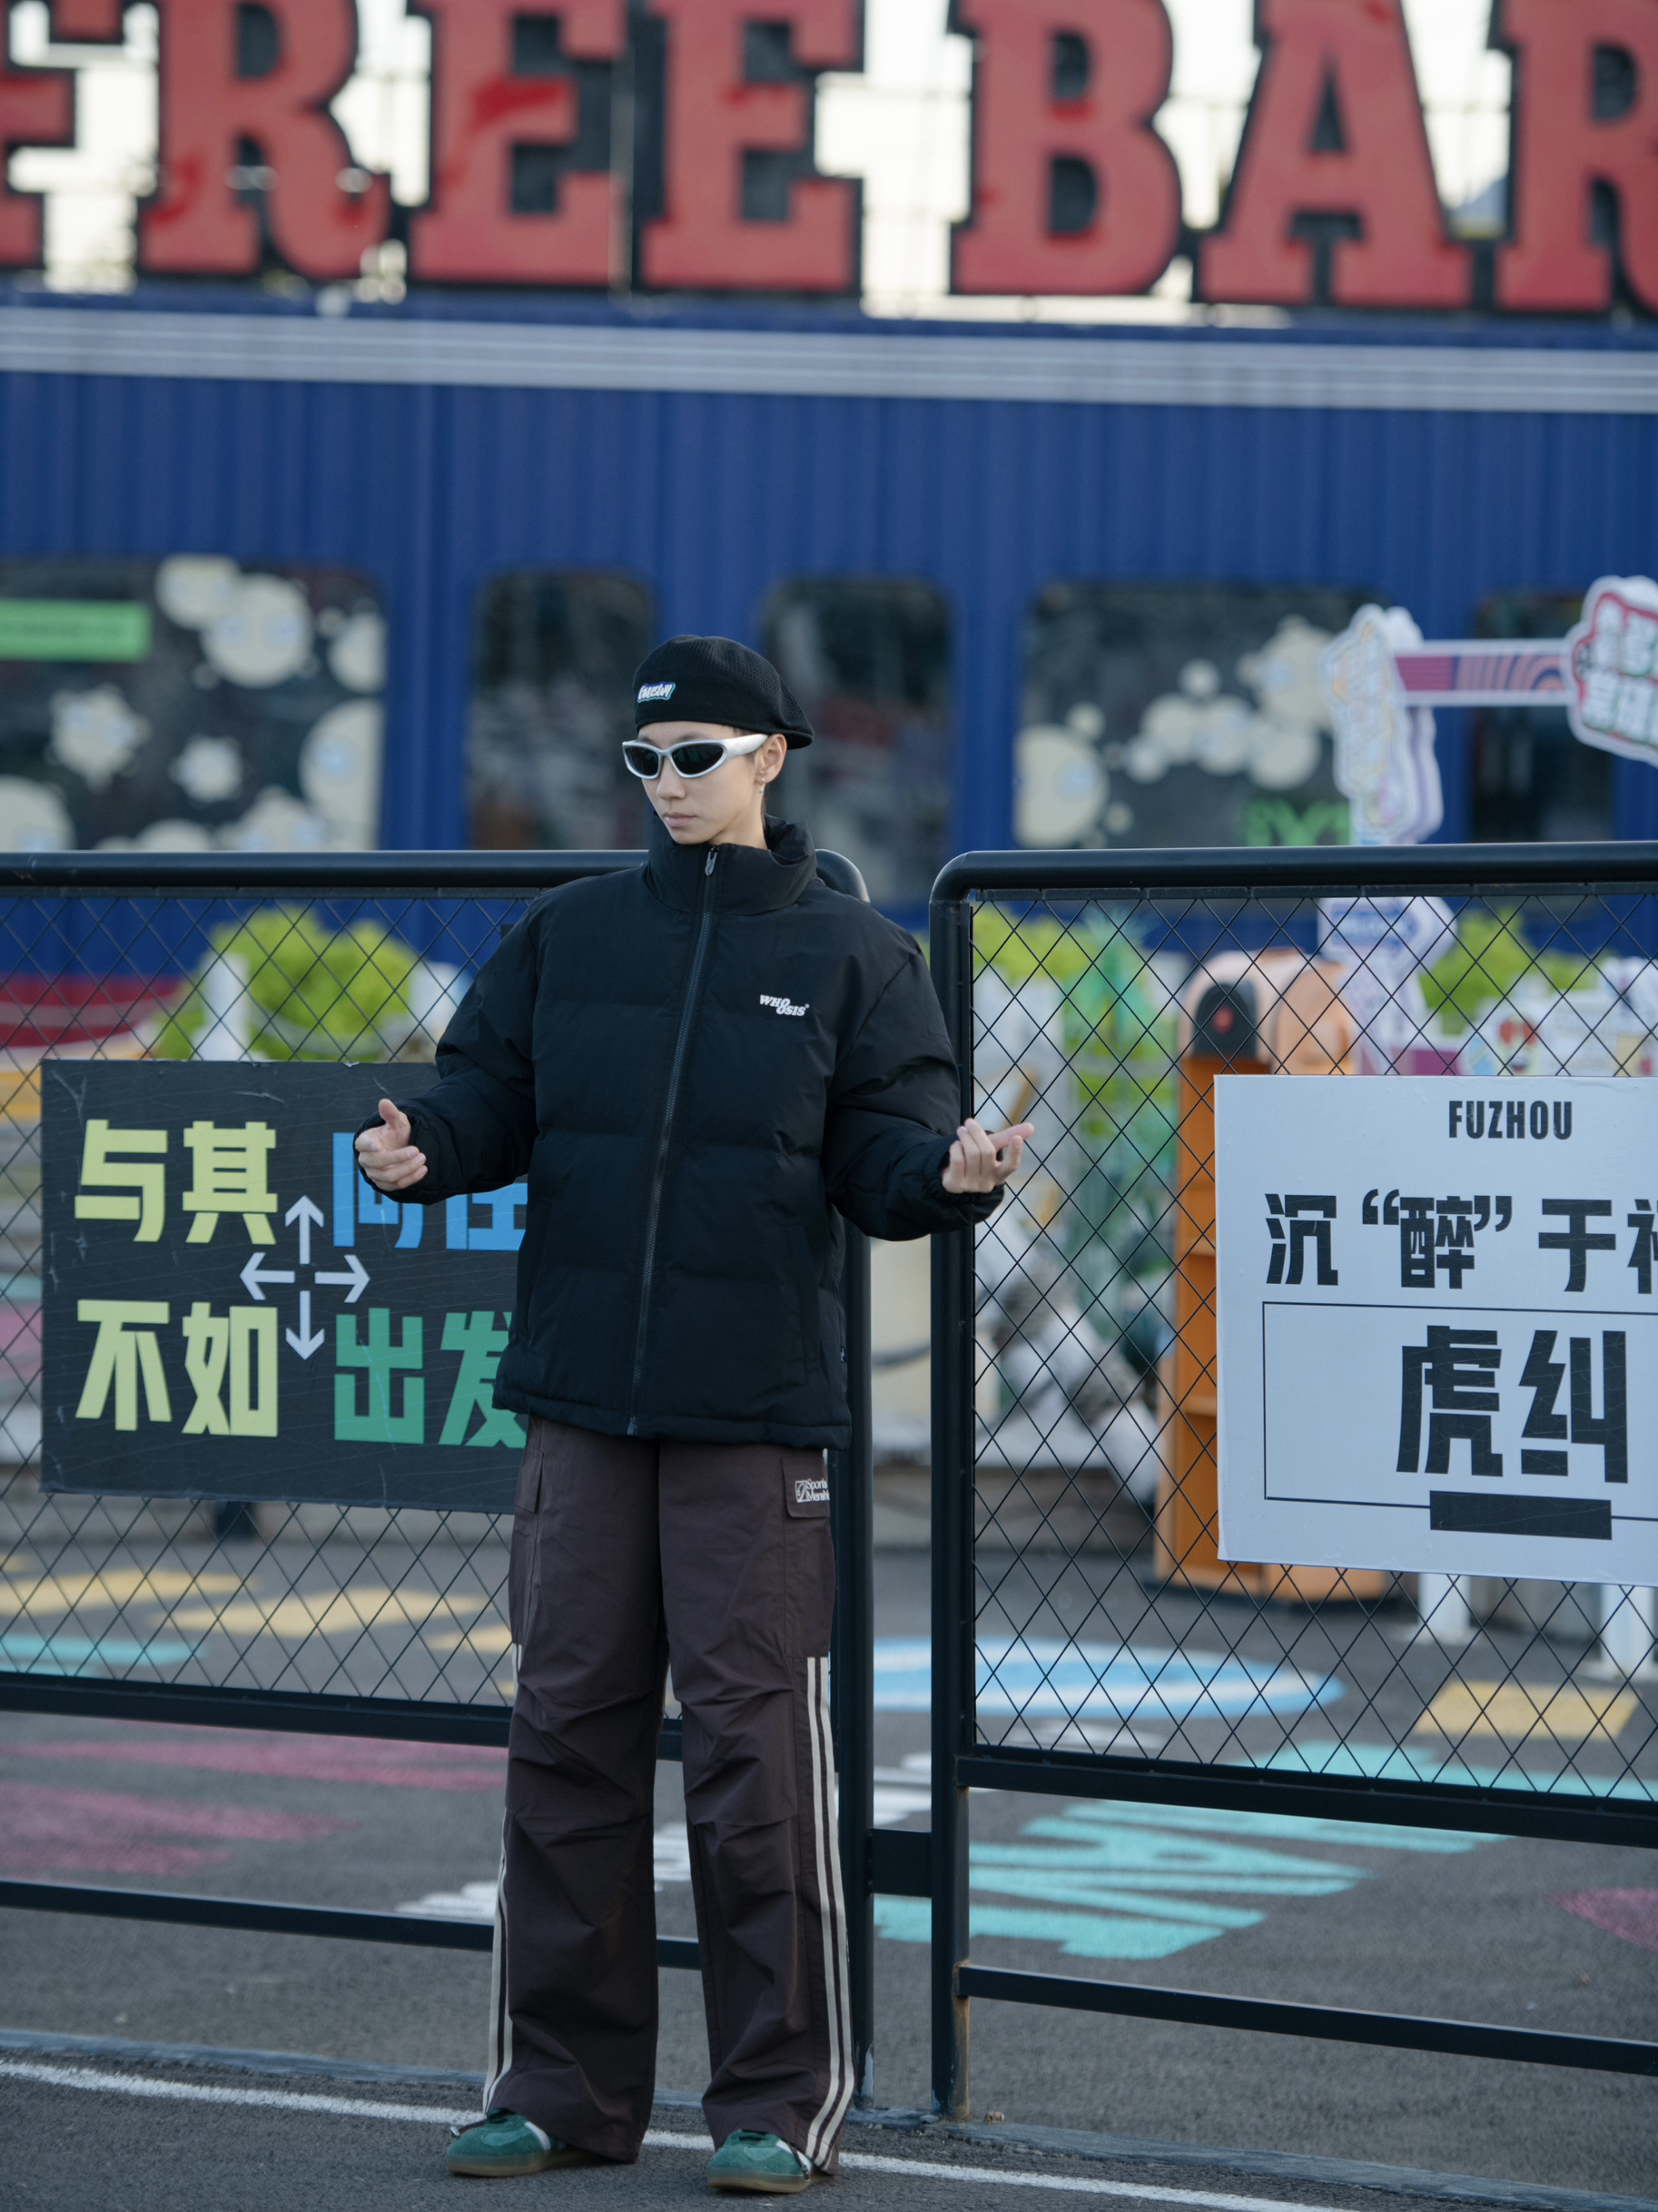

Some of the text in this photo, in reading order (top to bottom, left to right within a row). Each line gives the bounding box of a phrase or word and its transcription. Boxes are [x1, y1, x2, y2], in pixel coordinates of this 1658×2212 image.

[74, 1119, 278, 1245] 与其
[1448, 1101, 1573, 1140] FUZHOU
[75, 1299, 278, 1437] 不如
[1396, 1325, 1628, 1484] 虎纠
